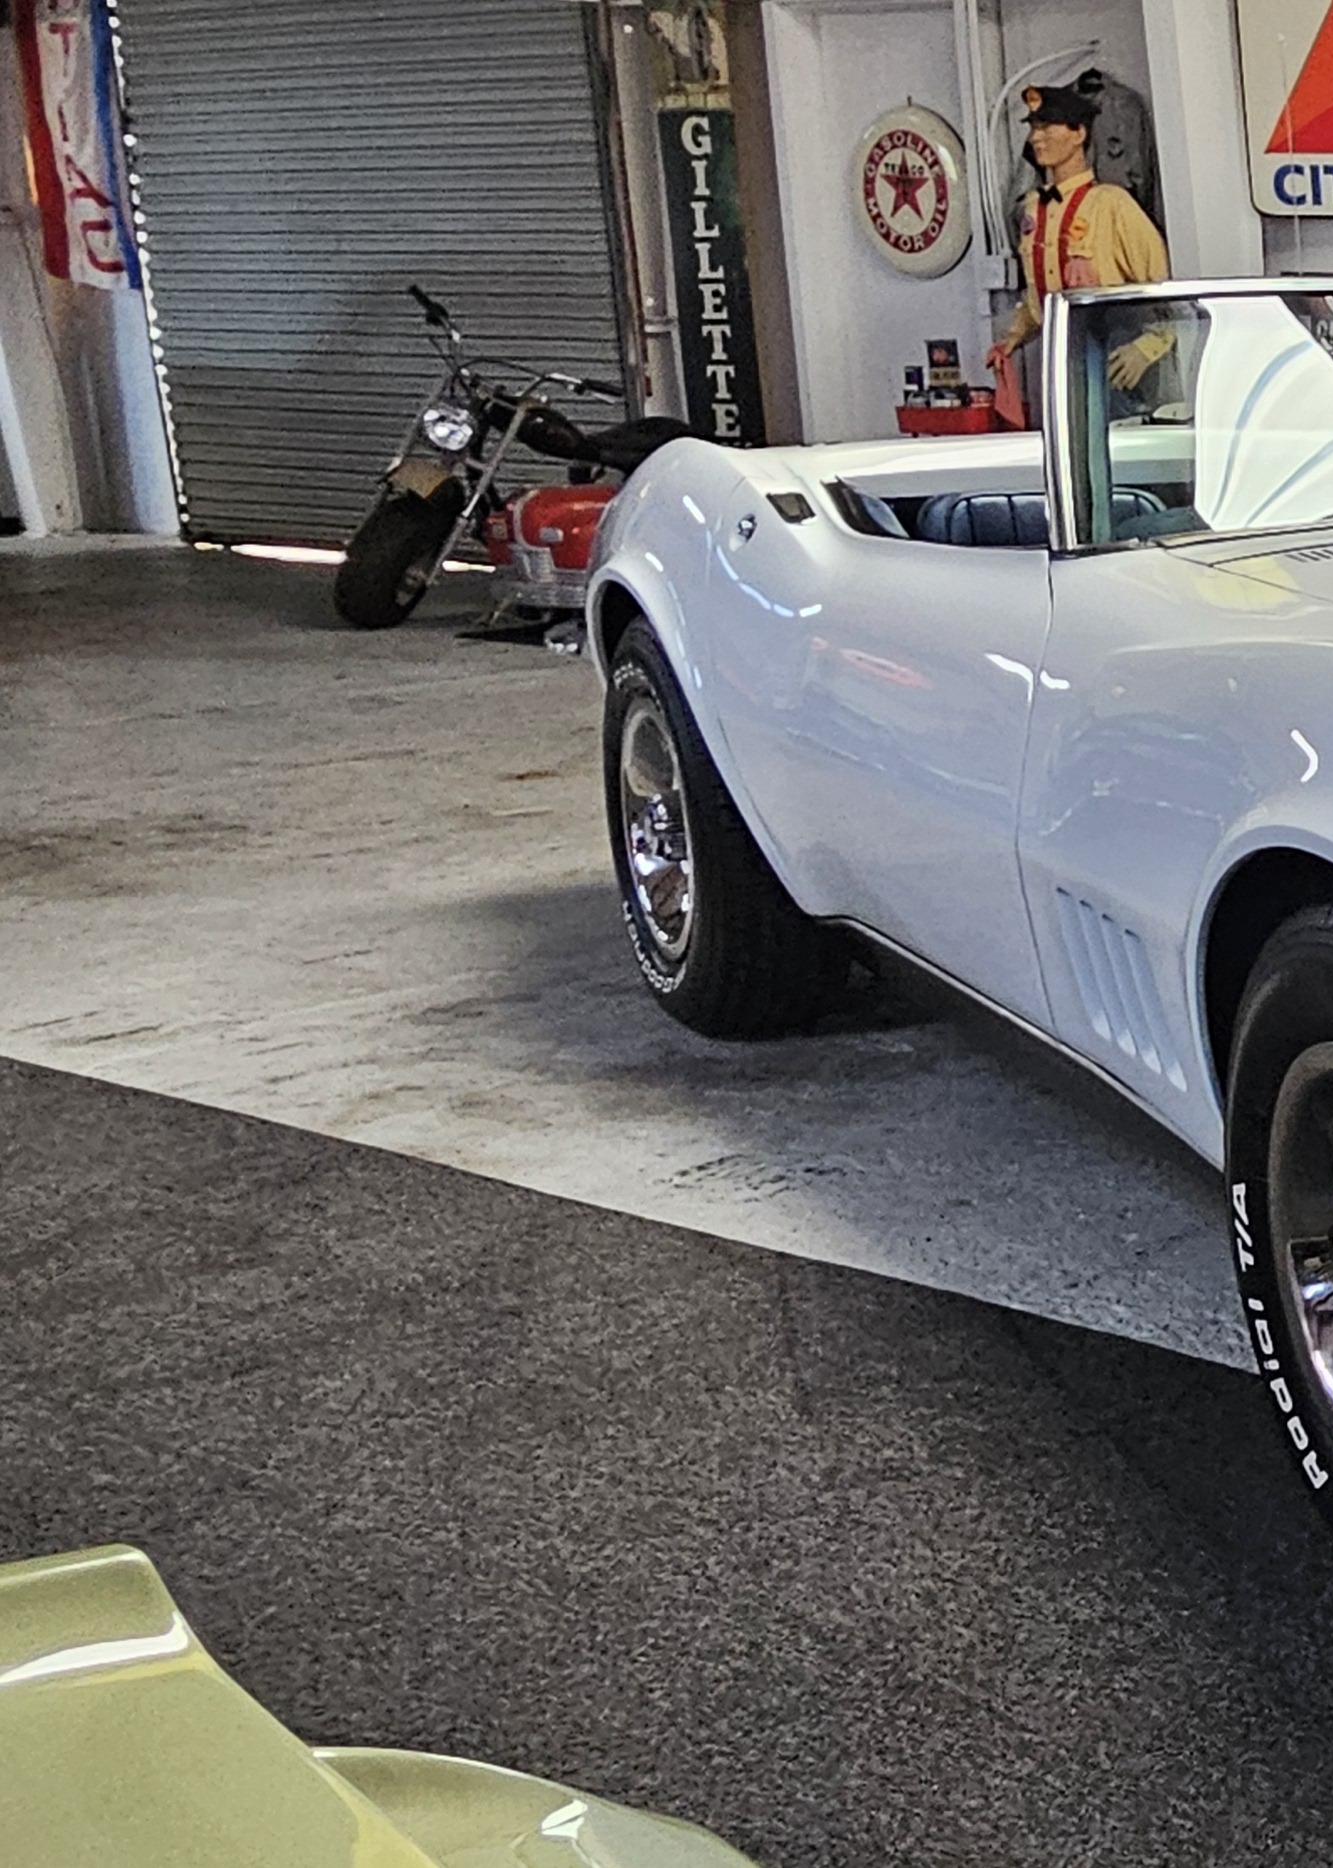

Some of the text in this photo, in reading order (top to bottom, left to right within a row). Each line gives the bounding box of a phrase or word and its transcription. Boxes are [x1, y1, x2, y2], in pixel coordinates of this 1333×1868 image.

[866, 131, 943, 177] GASOLINE
[884, 161, 925, 177] TECO
[867, 197, 948, 250] MOTOR OIL
[680, 115, 741, 438] GILLETTE
[1232, 1183, 1255, 1272] T/A
